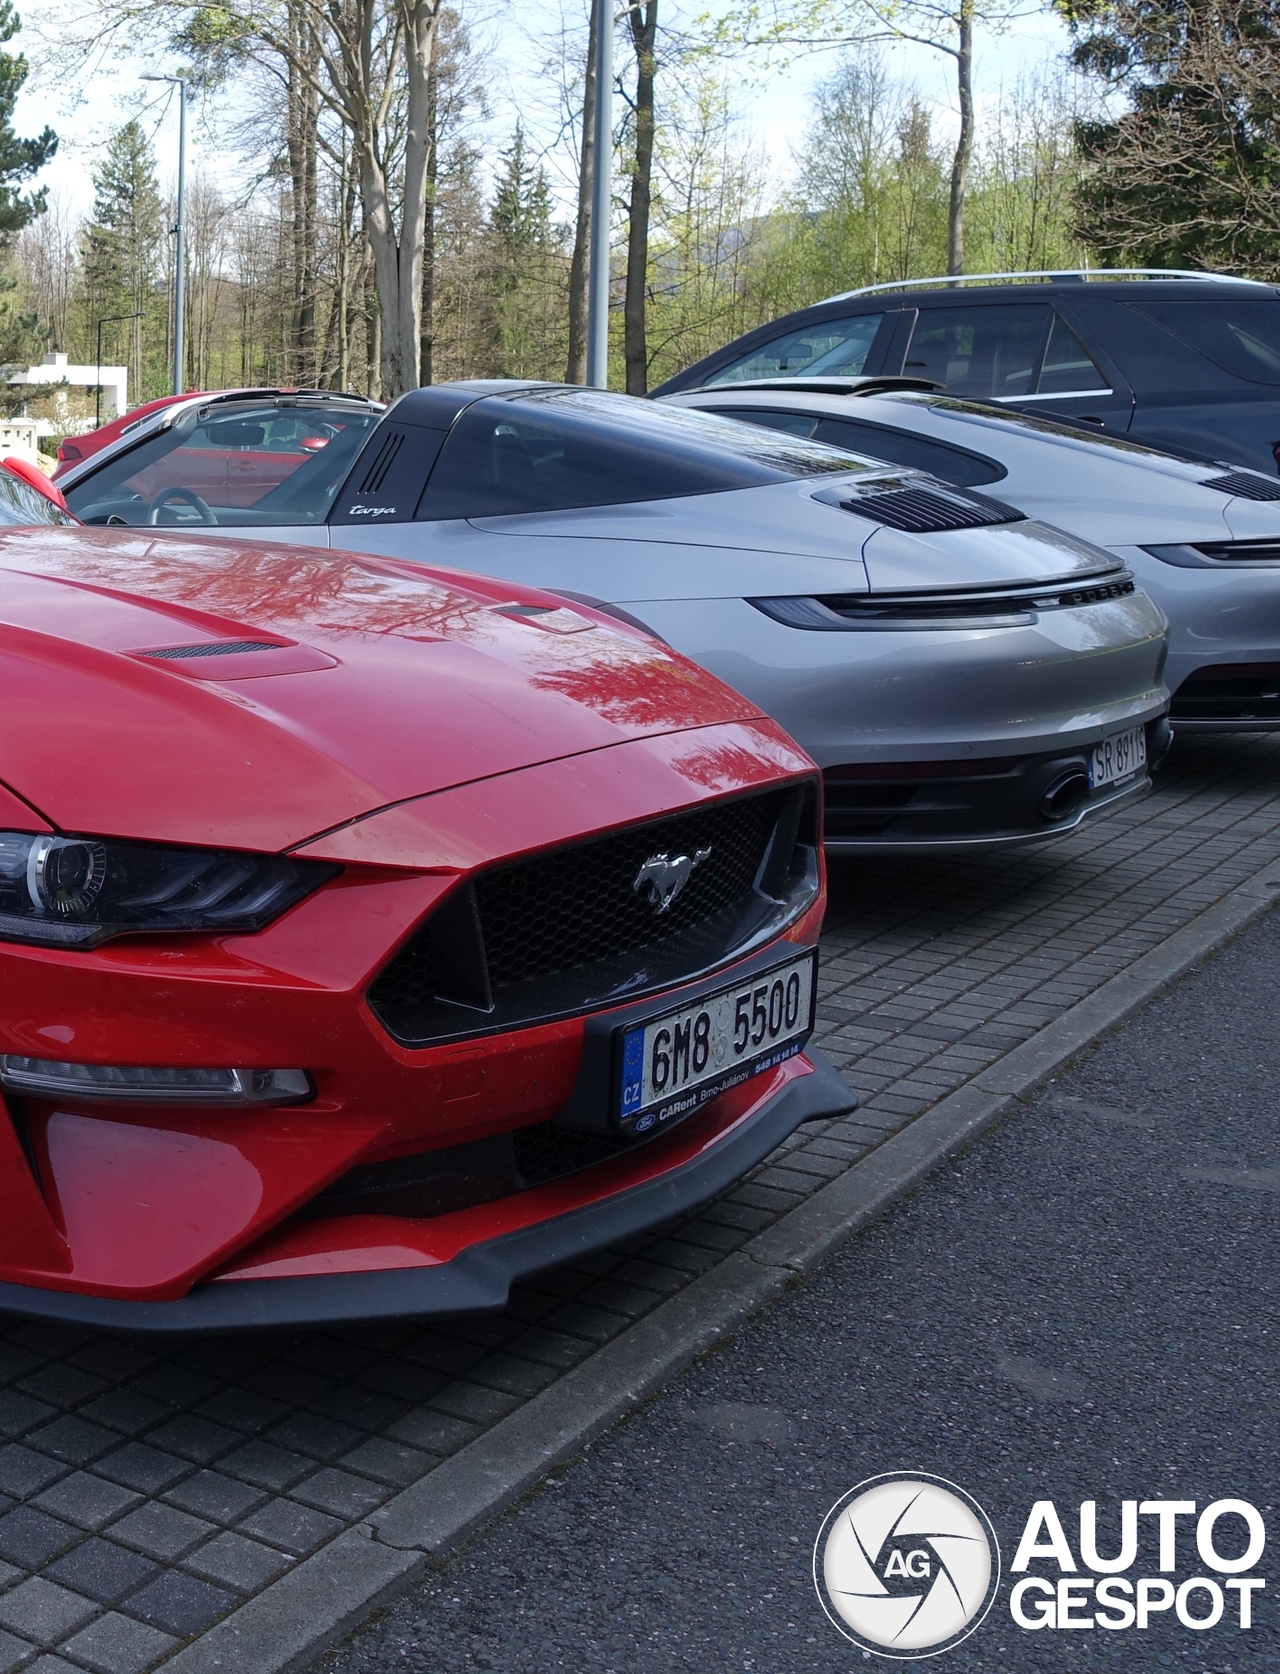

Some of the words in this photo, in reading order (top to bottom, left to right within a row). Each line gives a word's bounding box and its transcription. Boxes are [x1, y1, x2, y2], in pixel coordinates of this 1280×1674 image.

[1096, 741, 1113, 781] SR
[651, 1010, 711, 1091] 6M8
[733, 971, 800, 1054] 5500
[624, 1082, 640, 1106] CZ
[659, 1094, 697, 1121] CARent
